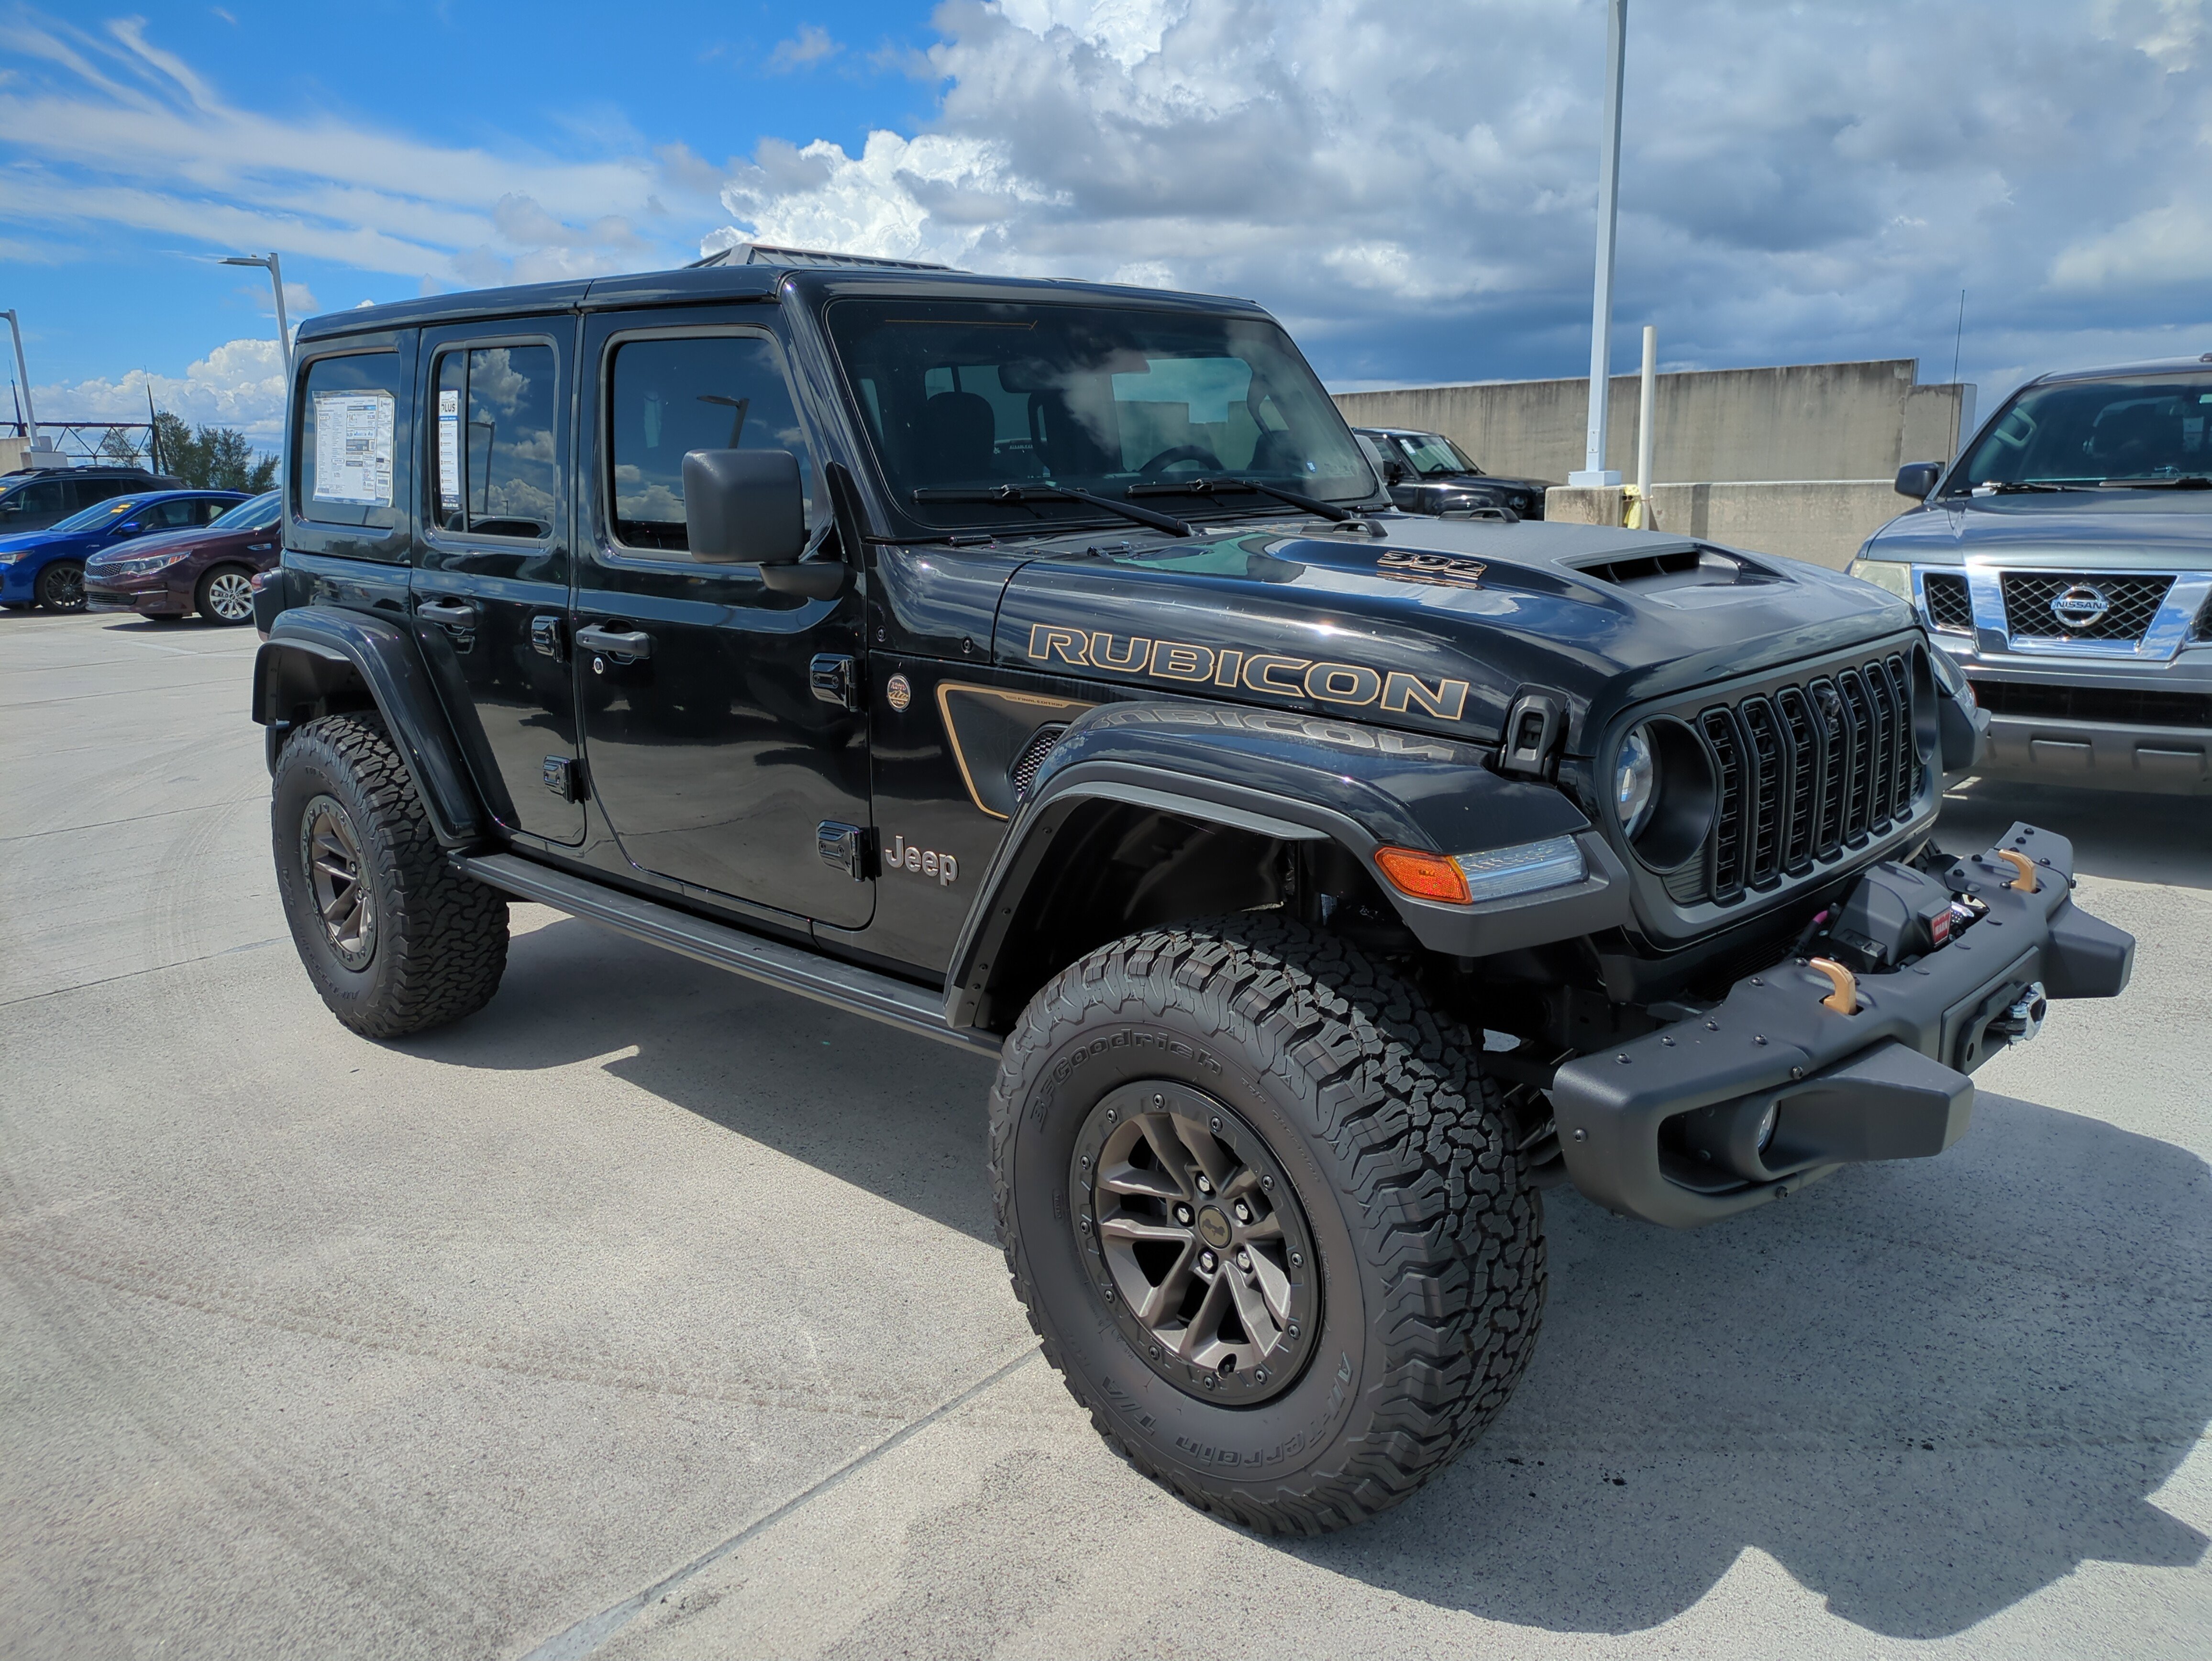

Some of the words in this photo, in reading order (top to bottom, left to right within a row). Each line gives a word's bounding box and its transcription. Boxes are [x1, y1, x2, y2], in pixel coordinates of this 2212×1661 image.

[1377, 550, 1488, 580] 392
[1028, 623, 1470, 720] RUBICON
[885, 835, 958, 886] Jeep
[1935, 919, 1948, 936] WARN
[1030, 1028, 1223, 1133] BFGoodrich
[1101, 1373, 1158, 1436] T/A
[1174, 1351, 1354, 1468] All-Terrain
